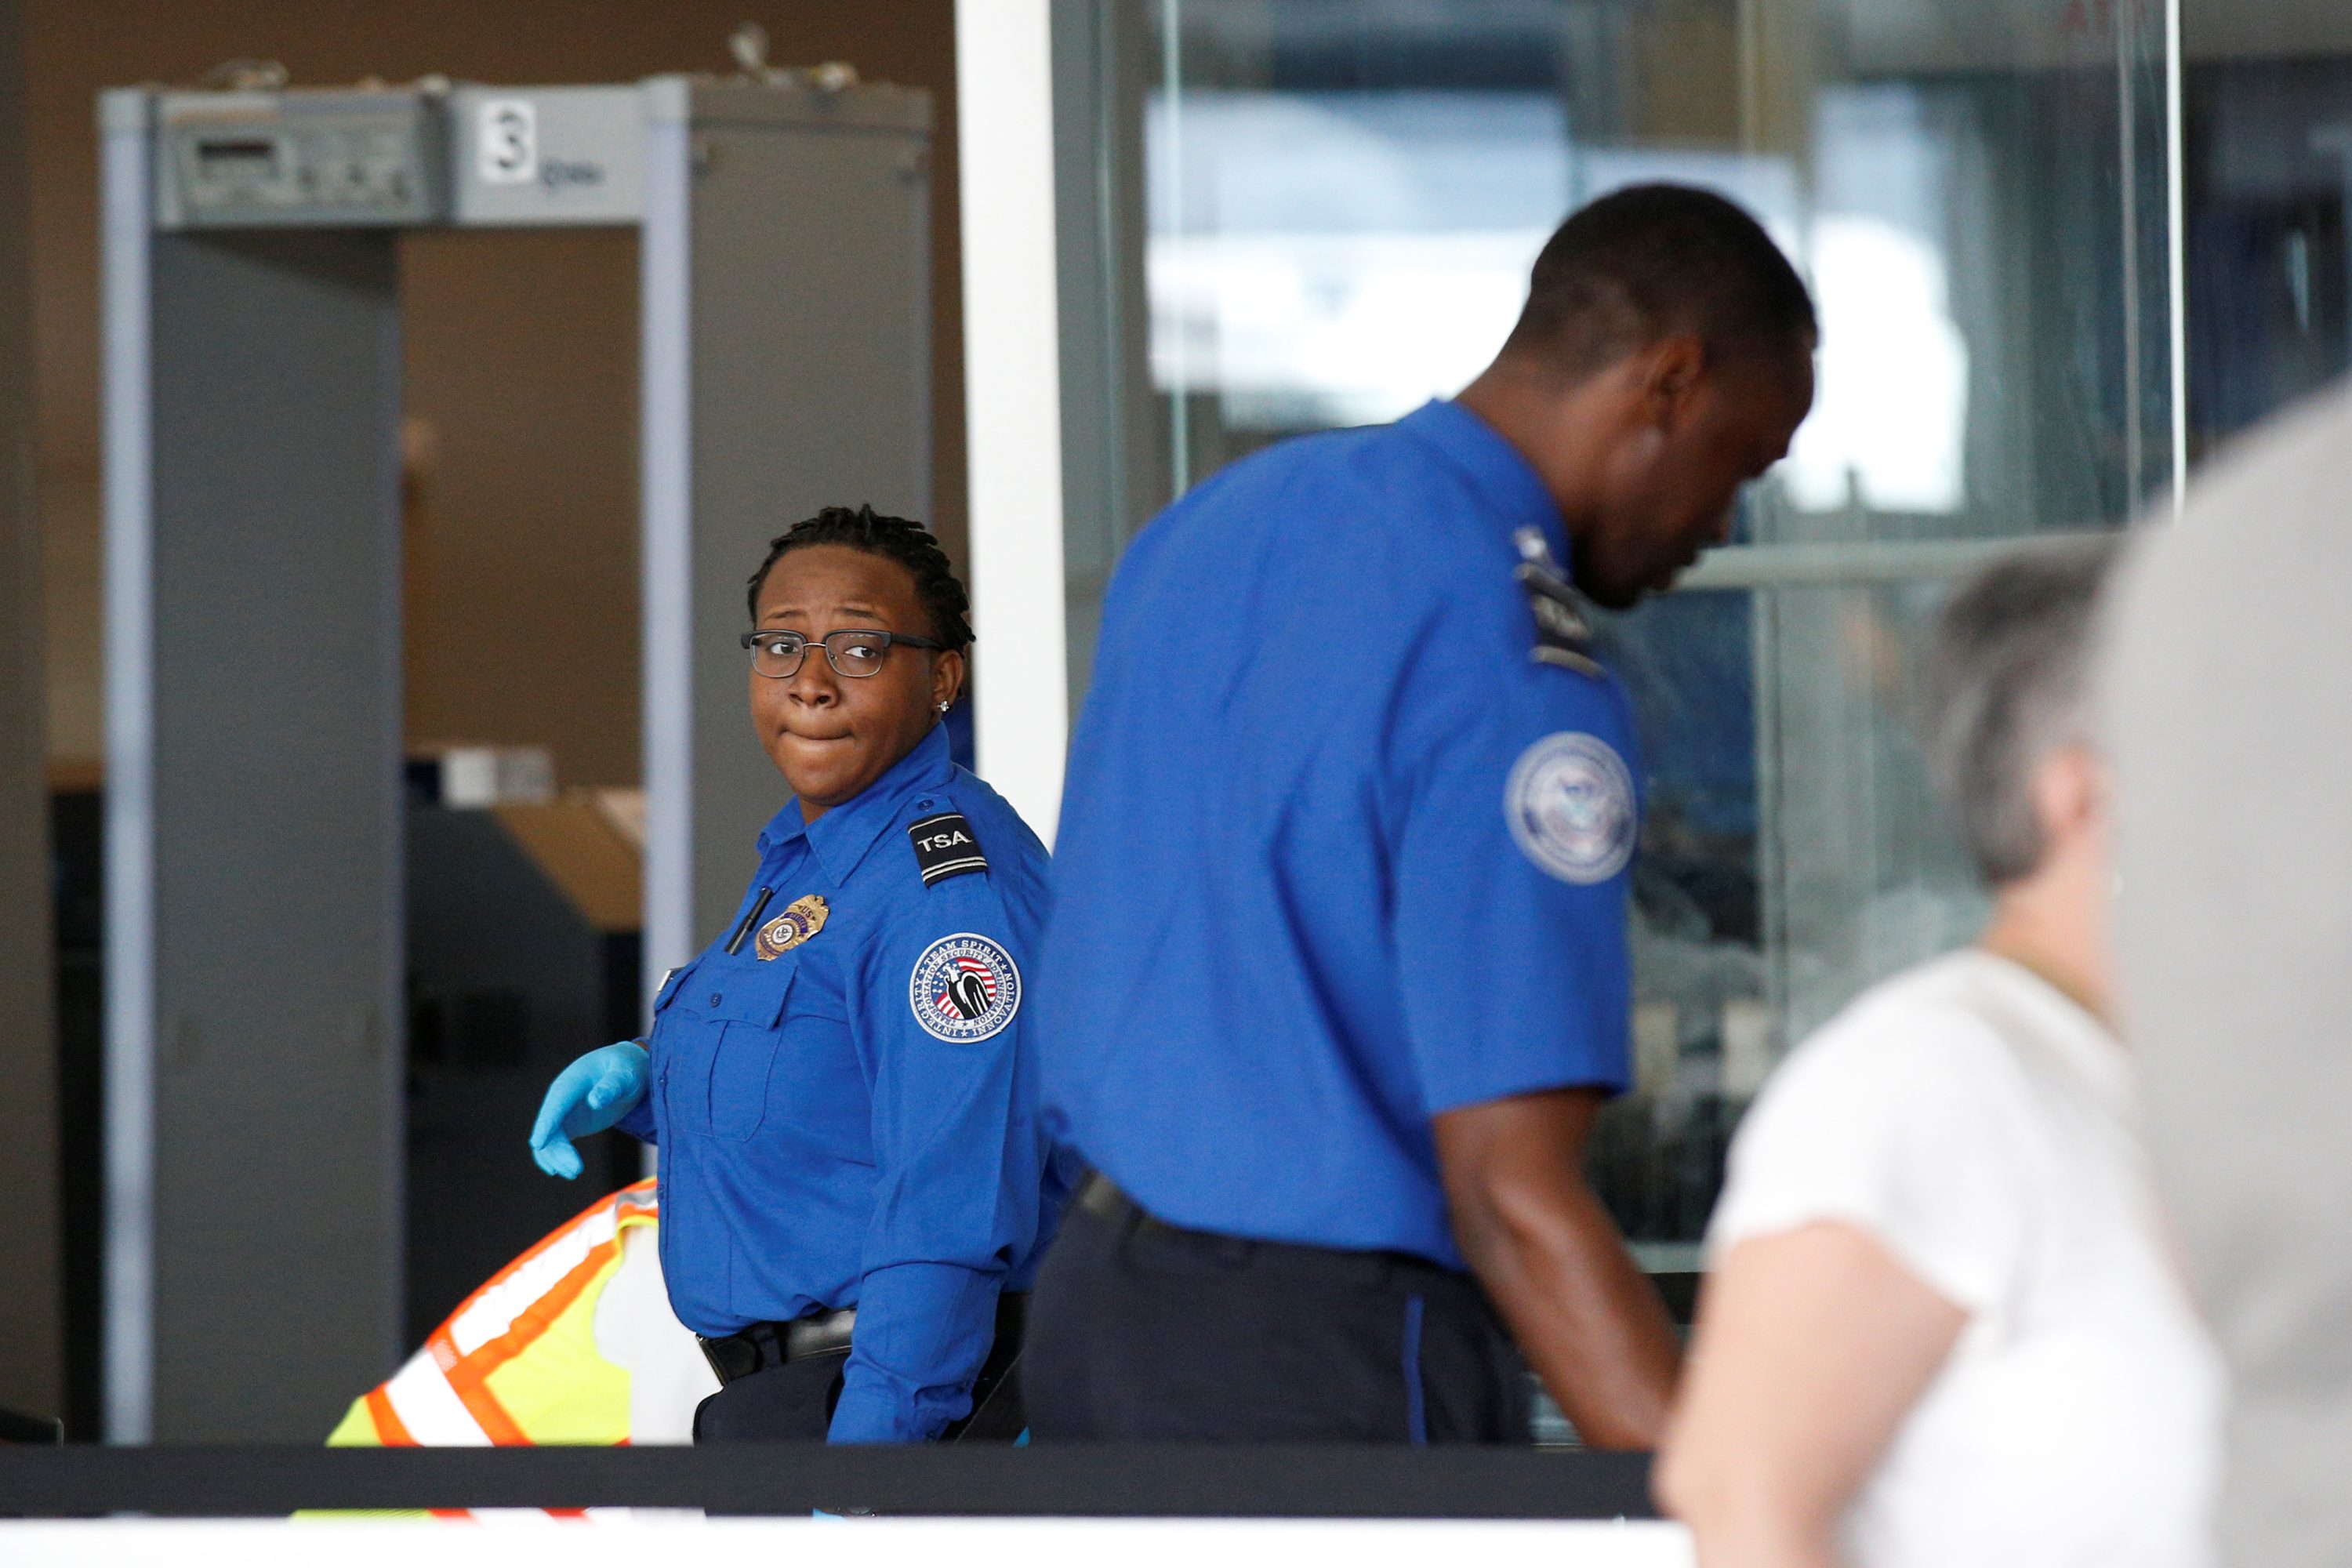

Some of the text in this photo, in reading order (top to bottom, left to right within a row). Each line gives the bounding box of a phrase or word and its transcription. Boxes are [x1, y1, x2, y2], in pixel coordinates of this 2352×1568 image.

[495, 111, 528, 170] 3
[916, 830, 971, 852] TSA
[924, 939, 1003, 966] TEAM SPIRIT
[915, 978, 957, 1036] INTEGRITY
[924, 949, 1005, 1027] TRANSPORTATION SECURITY ADMINISTRATION
[972, 972, 1014, 1036] INNOVATION
